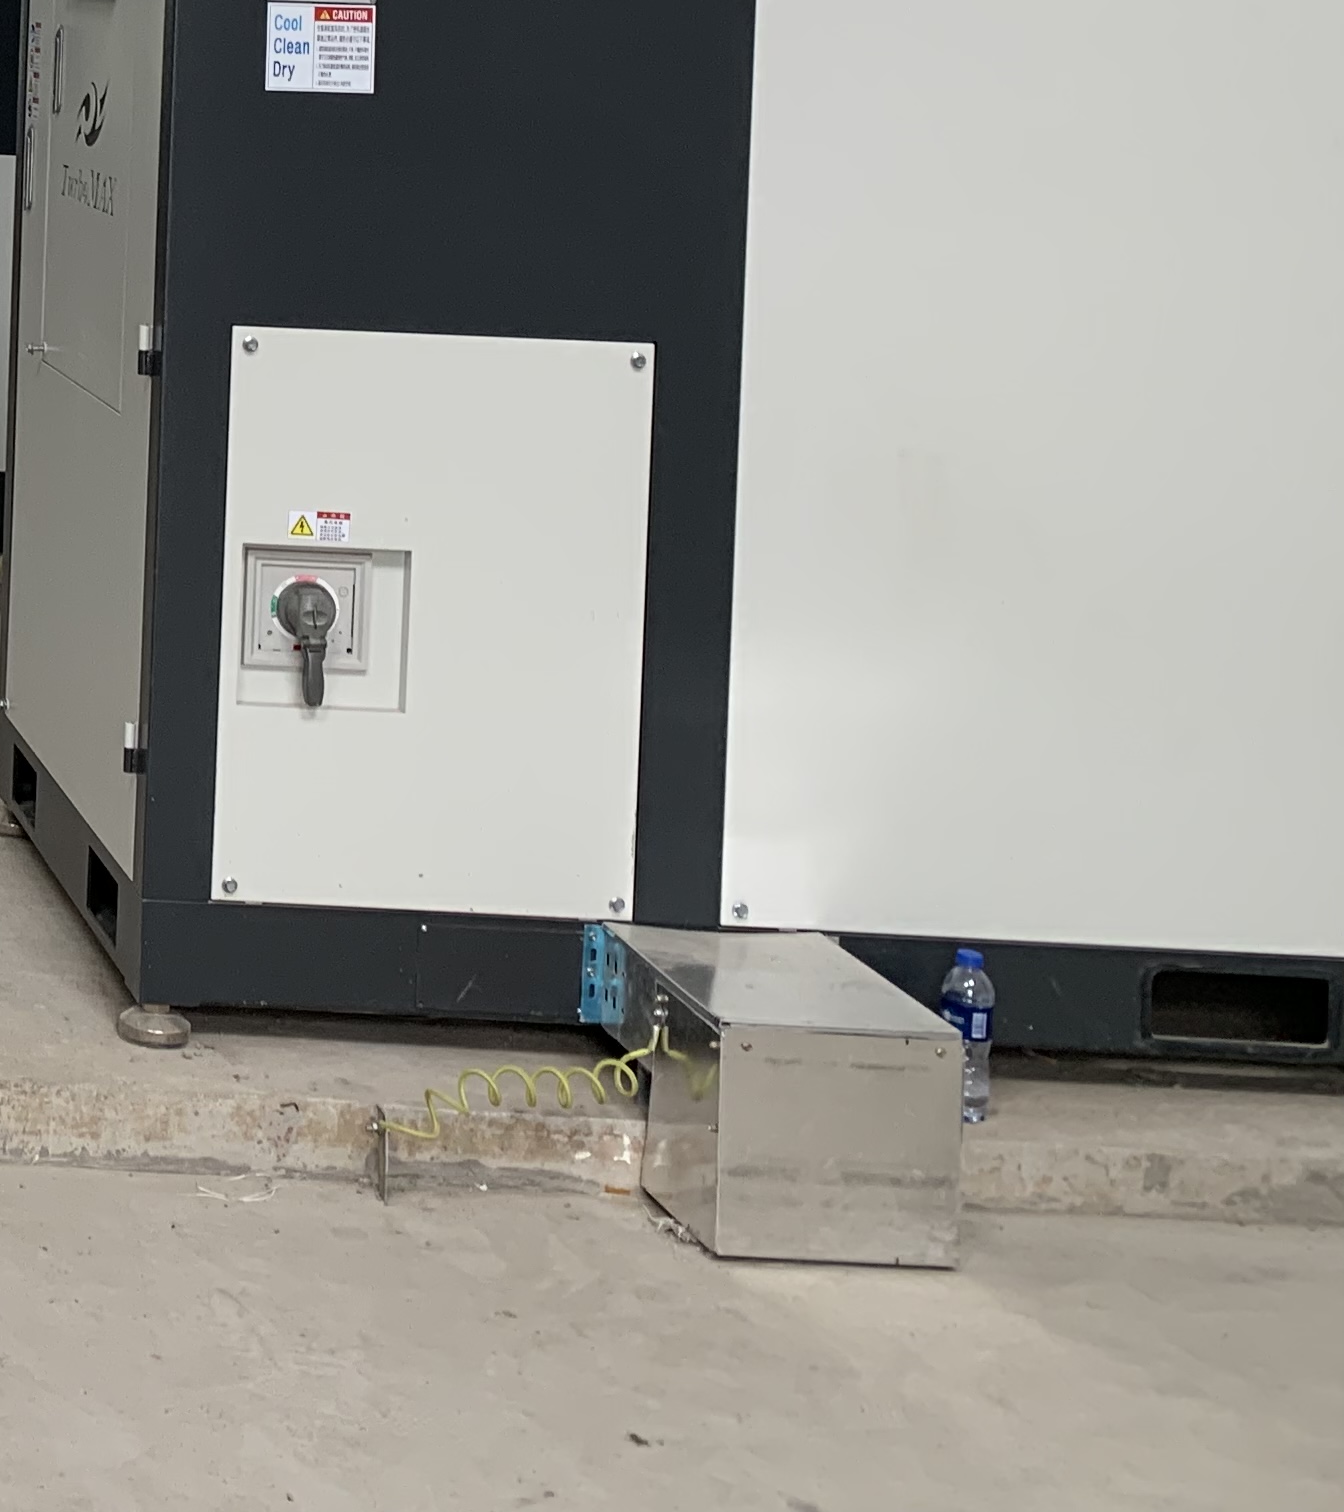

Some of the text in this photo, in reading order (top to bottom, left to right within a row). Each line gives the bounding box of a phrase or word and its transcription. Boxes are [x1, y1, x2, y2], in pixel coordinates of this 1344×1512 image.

[274, 14, 302, 31] Cool
[332, 9, 368, 21] CAUTION
[273, 37, 310, 55] Clean
[272, 60, 296, 81] Dry
